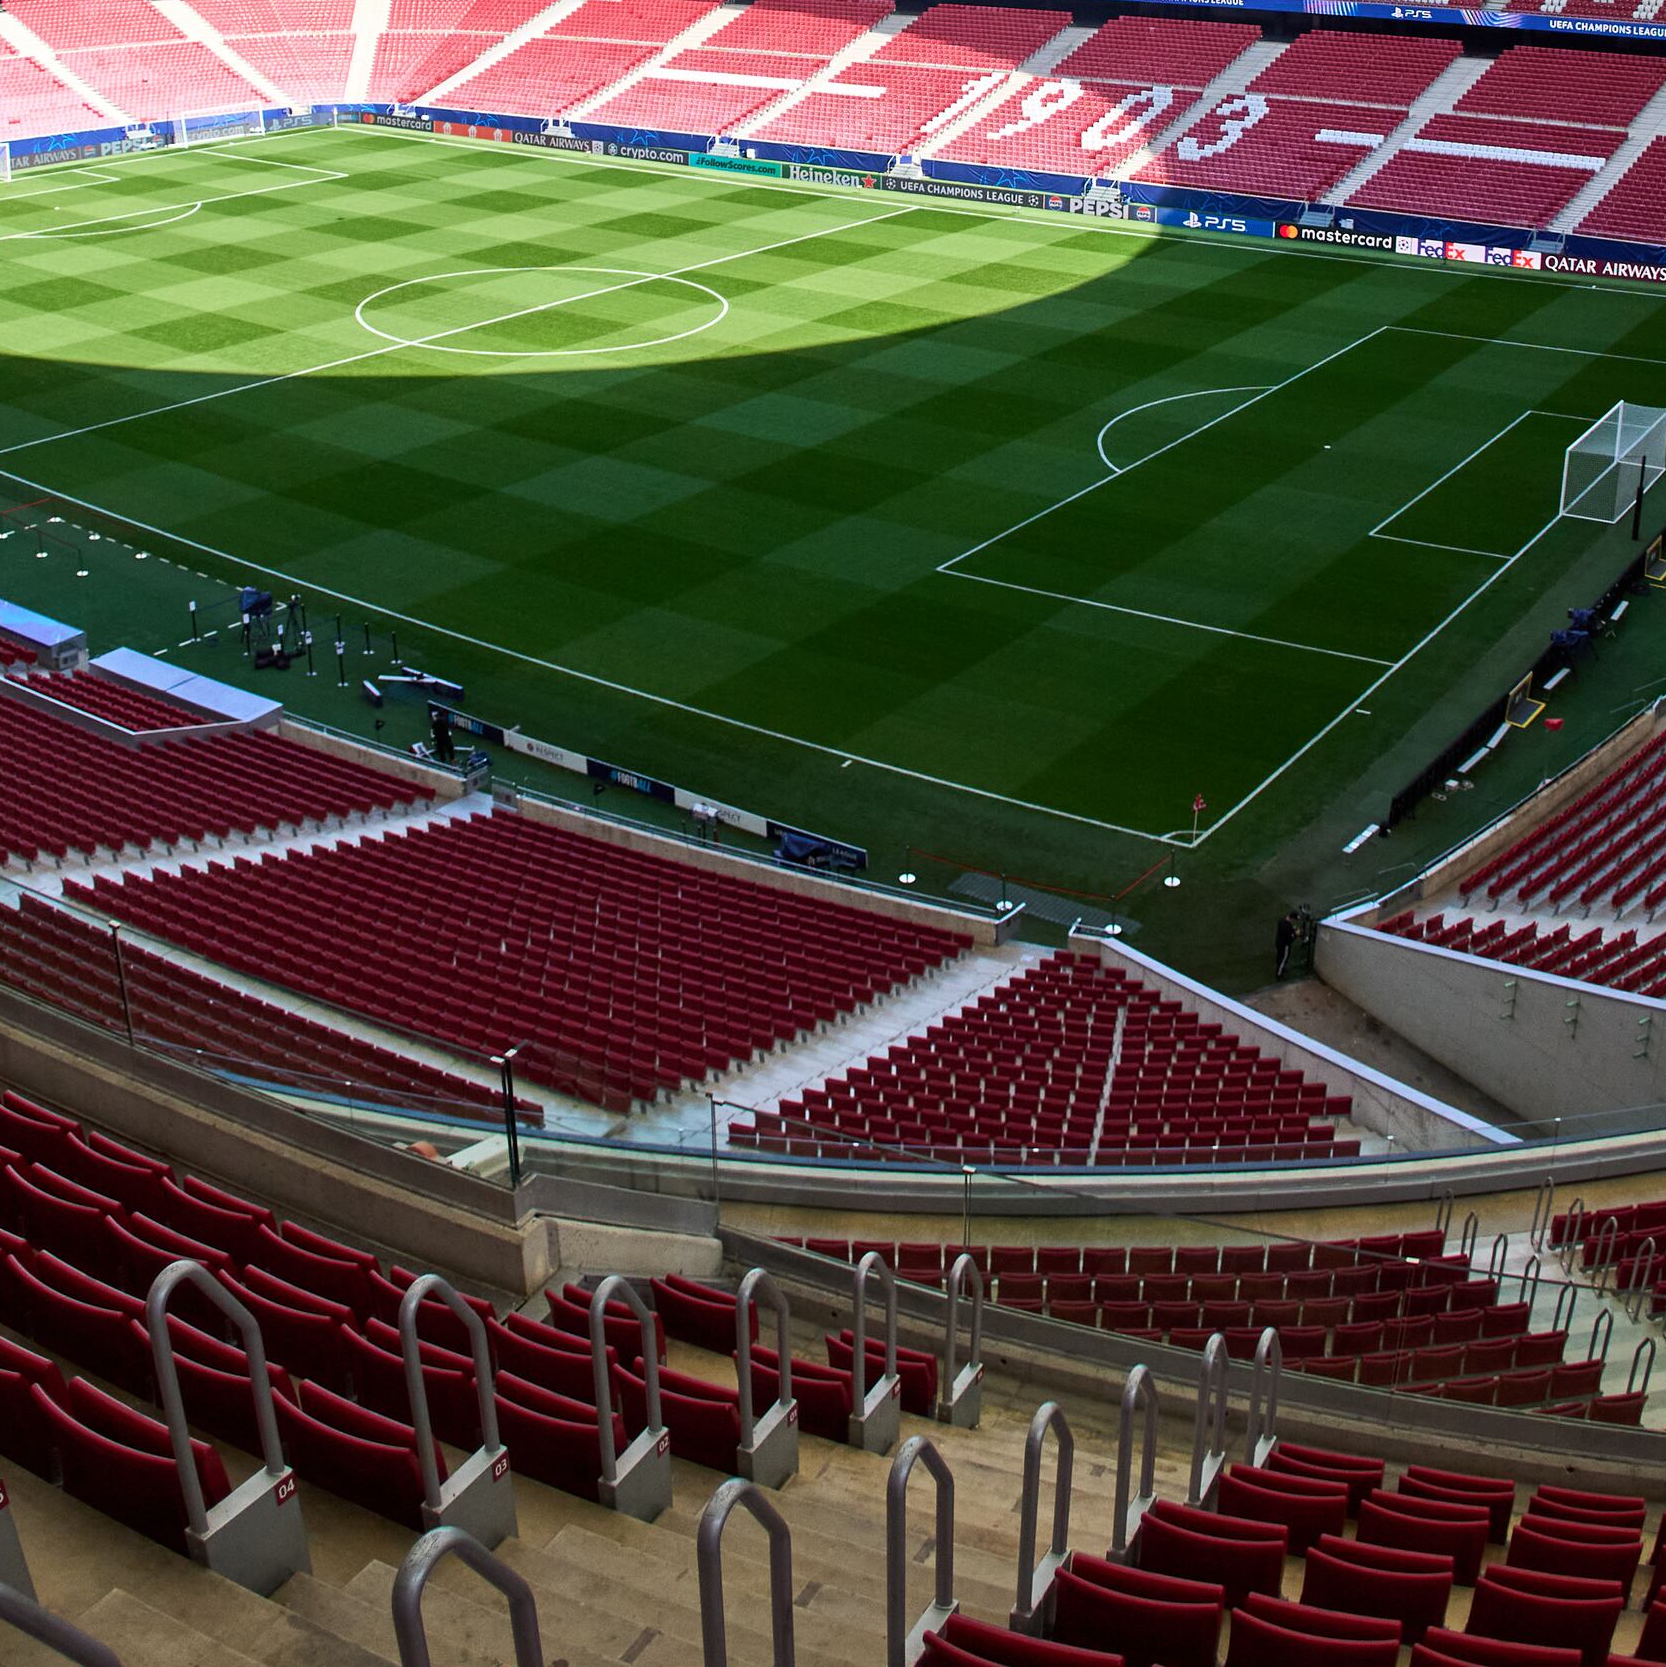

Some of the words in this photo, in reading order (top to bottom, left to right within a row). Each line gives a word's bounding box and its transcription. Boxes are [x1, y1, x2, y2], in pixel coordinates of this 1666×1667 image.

[1405, 9, 1432, 19] PS5
[1549, 19, 1574, 30] UEFA
[1575, 21, 1632, 35] CHAMPIONS
[284, 116, 313, 127] PS5
[376, 115, 432, 131] mastercard
[920, 71, 1270, 162] 1903
[515, 132, 546, 146] QATAR
[549, 137, 590, 151] AIRWAYS
[33, 149, 77, 165] AIRWAYS
[620, 146, 684, 163] crypto.com
[789, 166, 860, 187] Heineken
[900, 181, 925, 192] UEFA
[927, 184, 983, 199] CHAMPIONS
[986, 191, 1024, 203] LEAGUE
[1069, 198, 1129, 219] PEPSI
[1205, 215, 1246, 232] PS5
[1301, 227, 1393, 249] mastercard
[1418, 238, 1466, 261] FedEx
[1485, 246, 1534, 268] FedEx
[1545, 255, 1597, 274] QATAR
[659, 1436, 669, 1452] 02
[494, 1458, 508, 1476] 03
[278, 1478, 295, 1499] 04
